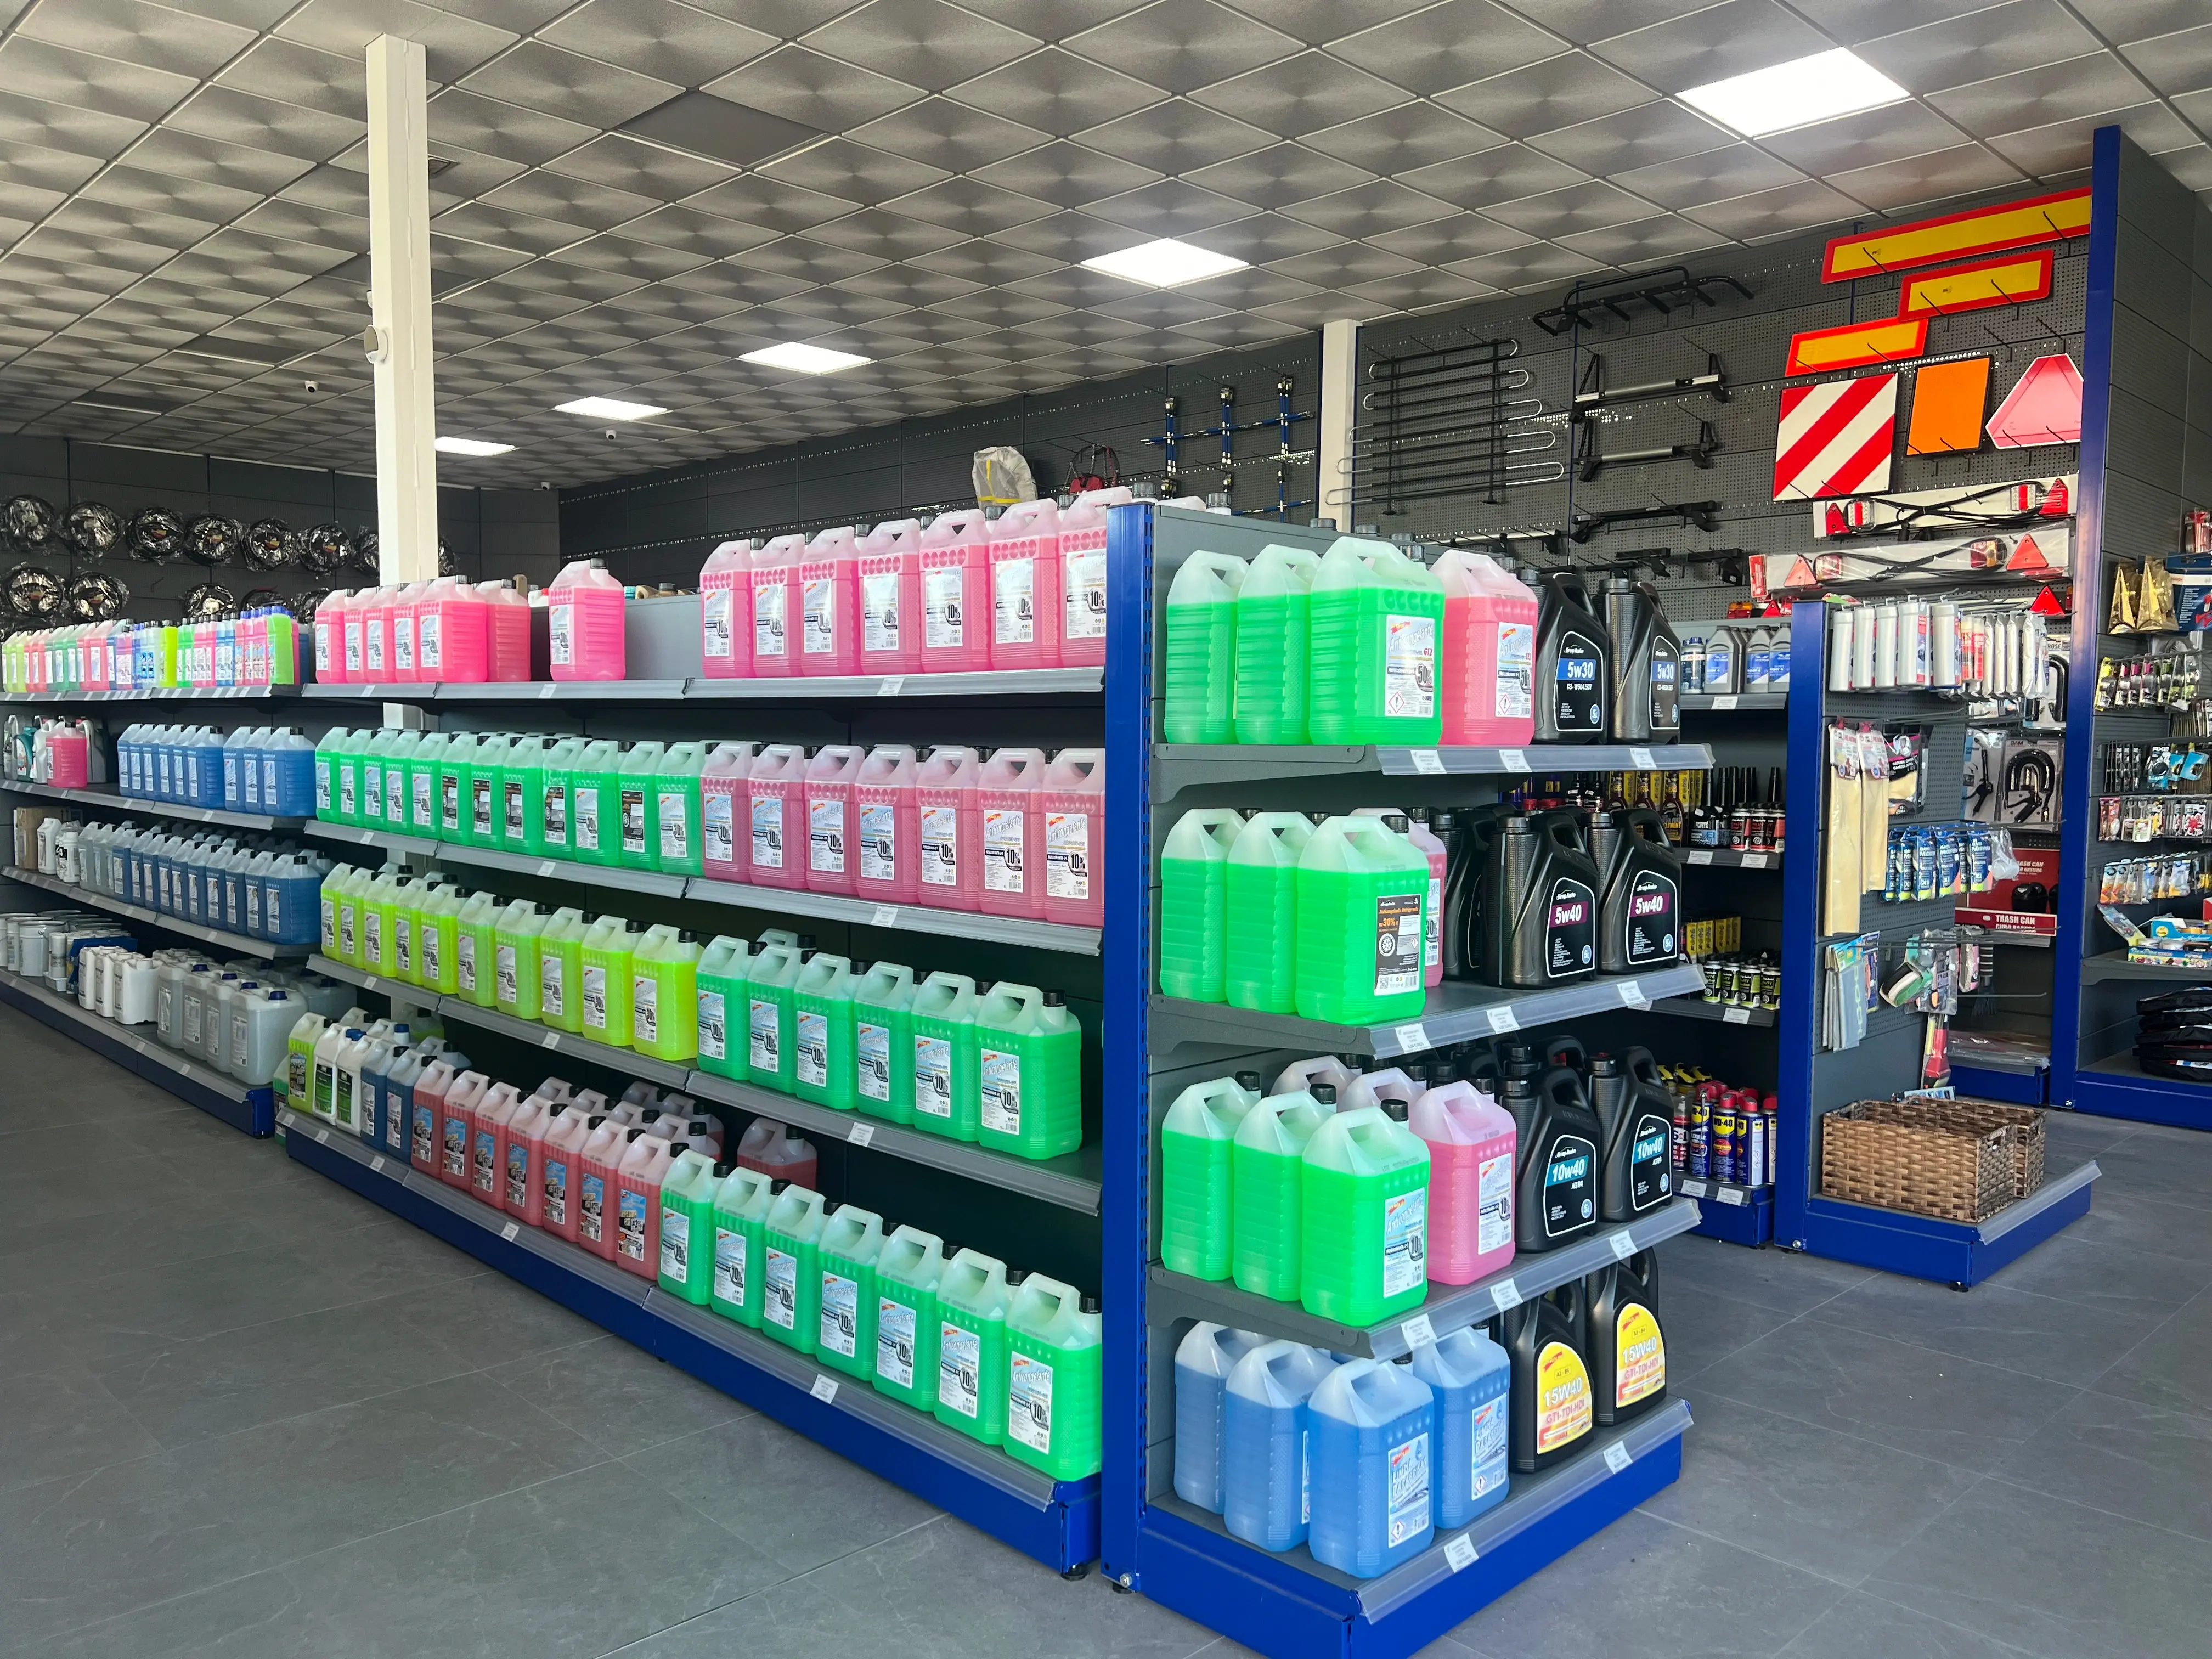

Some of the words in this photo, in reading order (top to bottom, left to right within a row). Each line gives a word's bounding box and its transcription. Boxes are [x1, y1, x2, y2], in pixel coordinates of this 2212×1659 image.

[1018, 597, 1031, 613] 10%
[1090, 590, 1105, 607] 10%
[947, 603, 960, 618] 10%
[1424, 647, 1432, 656] G12
[1567, 661, 1593, 678] 5w30
[1657, 663, 1674, 679] 5w30
[769, 831, 780, 845] 10%
[1048, 817, 1086, 843] Anticongelante
[830, 834, 842, 849] 10%
[879, 840, 892, 855] 10%
[941, 843, 953, 859] 10%
[1007, 849, 1021, 864] 10%
[1070, 854, 1085, 870] 10%
[1635, 895, 1663, 914] 5w40
[1383, 918, 1395, 927] 30%
[1555, 904, 1582, 925] 5w40
[1995, 915, 2019, 923] TRASH
[2020, 916, 2035, 925] CAN
[766, 1035, 776, 1048] 10%
[814, 1048, 825, 1063] 10%
[876, 1061, 887, 1077] 10%
[983, 1059, 1018, 1076] Anticongelante
[935, 1075, 948, 1091] 10%
[1003, 1091, 1017, 1108] 10%
[1637, 1136, 1663, 1160] 10w40
[1552, 1158, 1585, 1182] 10w40
[1500, 1197, 1510, 1214] 10%
[1410, 1235, 1423, 1254] 10%
[731, 1266, 743, 1282] 10%
[782, 1289, 793, 1305] 10%
[840, 1314, 854, 1330] 10%
[899, 1340, 912, 1361] 10%
[943, 1338, 978, 1352] Anticongelante
[1622, 1336, 1657, 1363] 15W40
[1624, 1356, 1659, 1380] GTI-TDI-HDI
[962, 1371, 975, 1390] 10%
[1012, 1367, 1050, 1387] Anticongelante
[1543, 1377, 1583, 1407] 15W40
[1033, 1403, 1048, 1423] 10%
[1547, 1398, 1585, 1425] GTI-TDI-HDI
